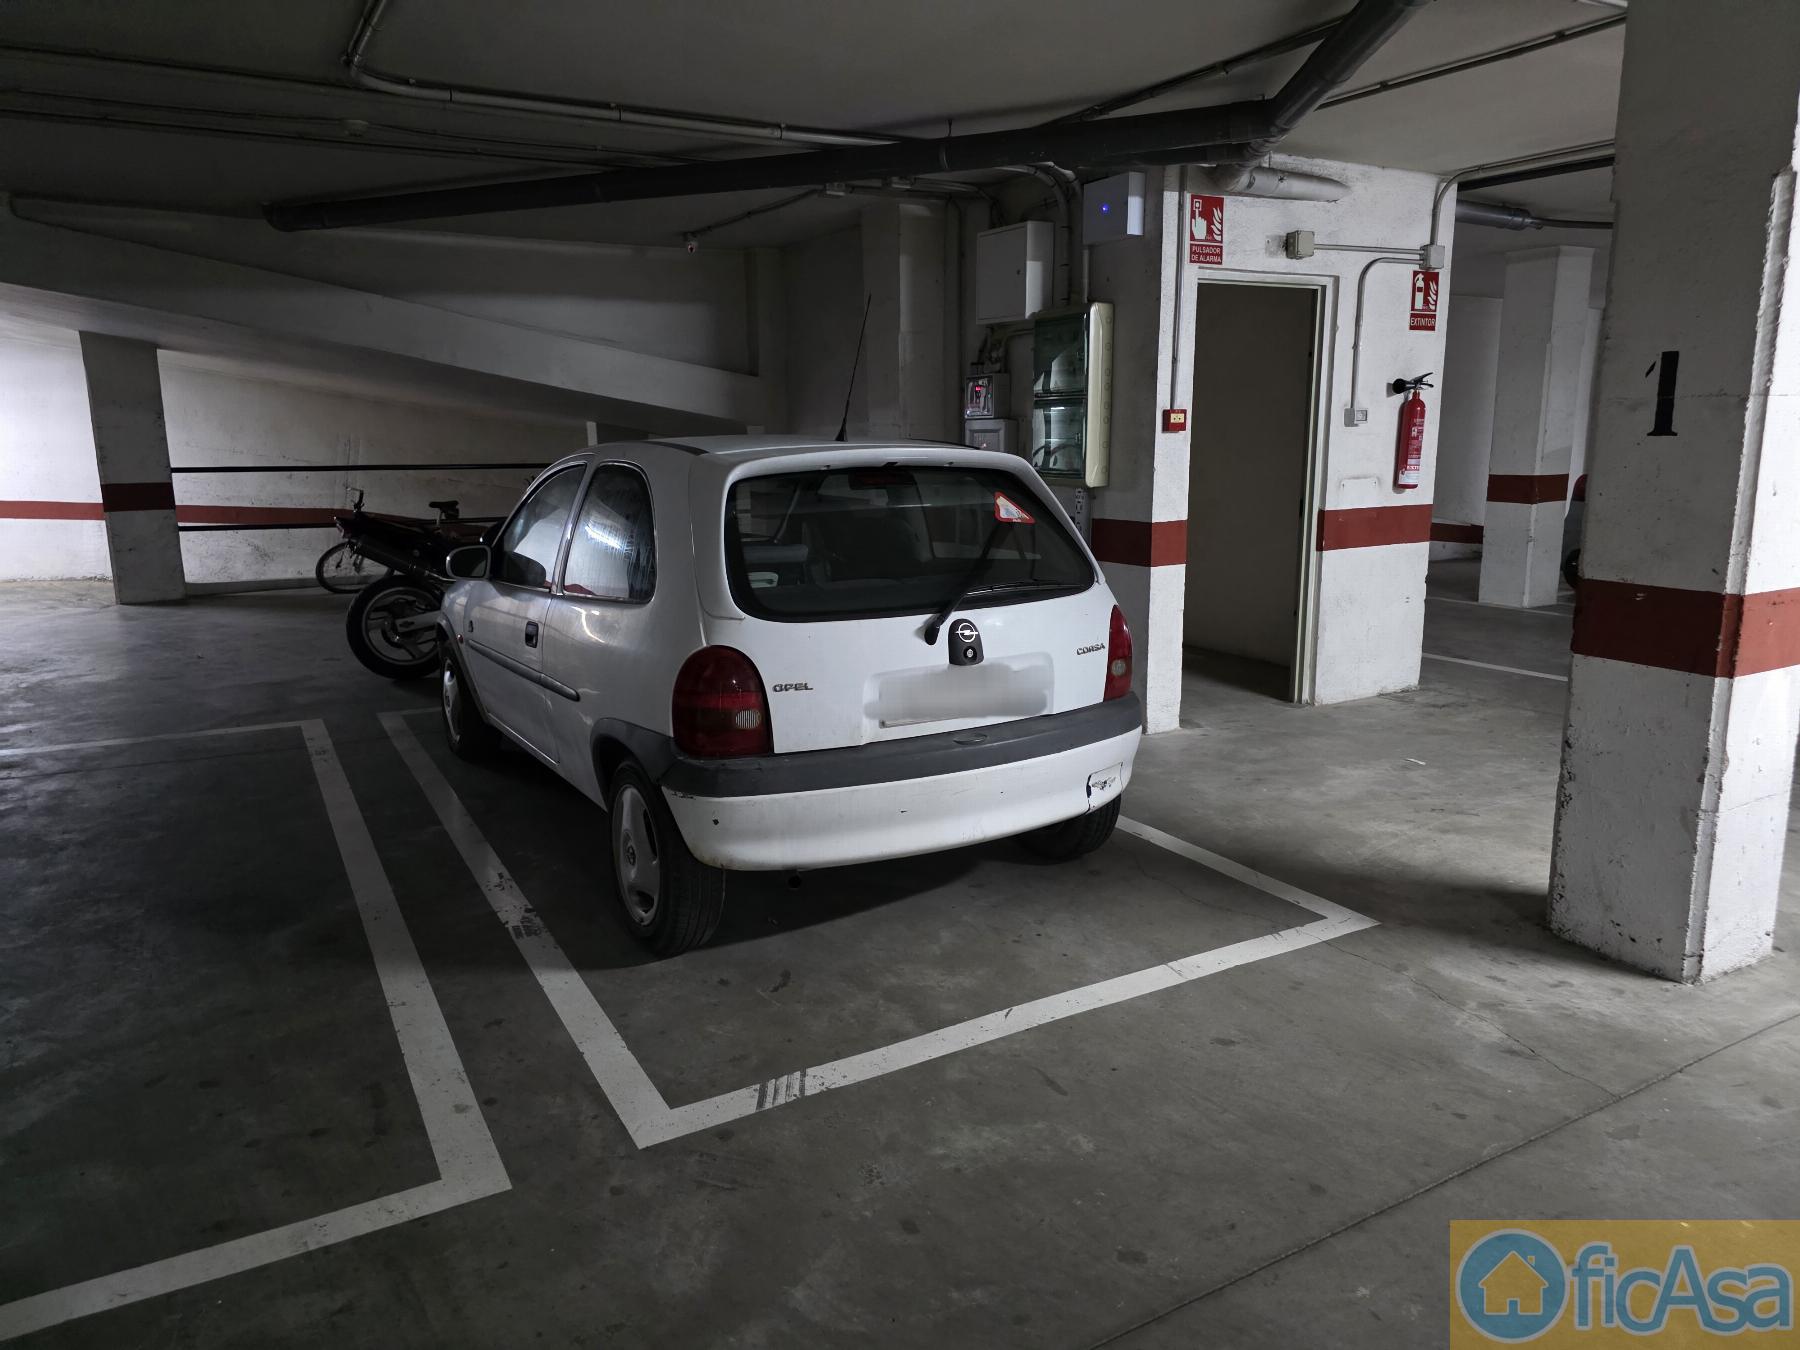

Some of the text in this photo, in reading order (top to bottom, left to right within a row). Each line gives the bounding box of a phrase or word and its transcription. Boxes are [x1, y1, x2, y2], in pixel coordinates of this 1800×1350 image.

[1192, 245, 1221, 254] PULSADOR
[1200, 254, 1222, 263] ALARMA
[1410, 317, 1436, 327] EXTINTOR
[1645, 350, 1679, 436] 1
[1076, 642, 1106, 656] CORSA
[772, 682, 814, 693] OPEL
